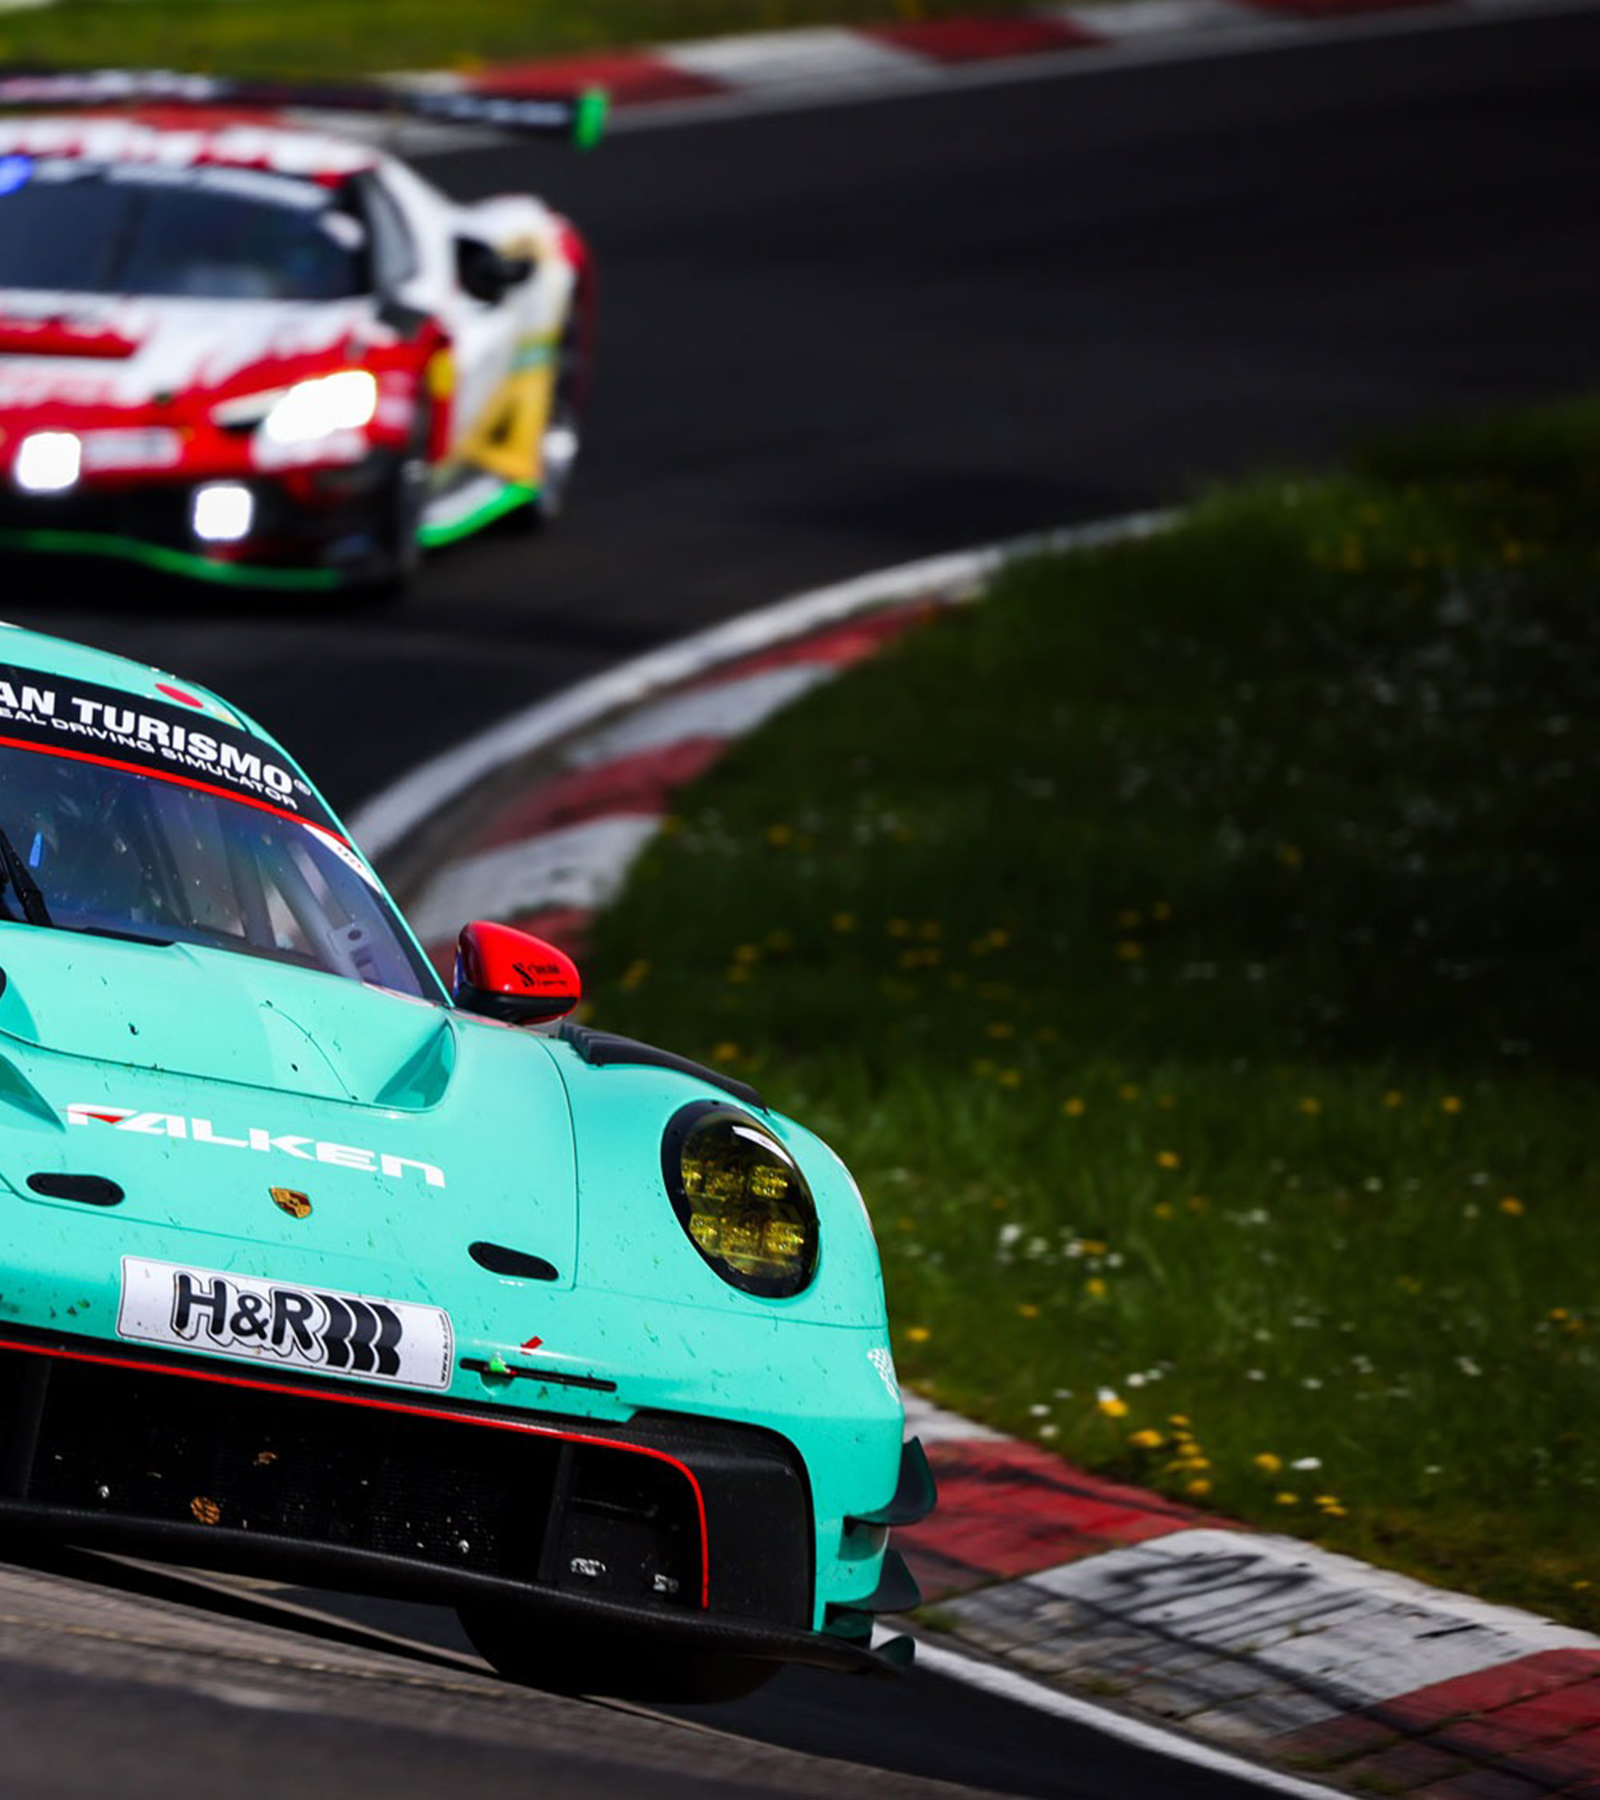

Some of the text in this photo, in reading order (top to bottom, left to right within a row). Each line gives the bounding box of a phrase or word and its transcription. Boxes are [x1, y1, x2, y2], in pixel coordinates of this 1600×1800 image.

[50, 718, 156, 754] DRIVING
[160, 747, 299, 810] SIMULATOR
[64, 1103, 446, 1188] FALKEN
[174, 1273, 315, 1351] H&R
